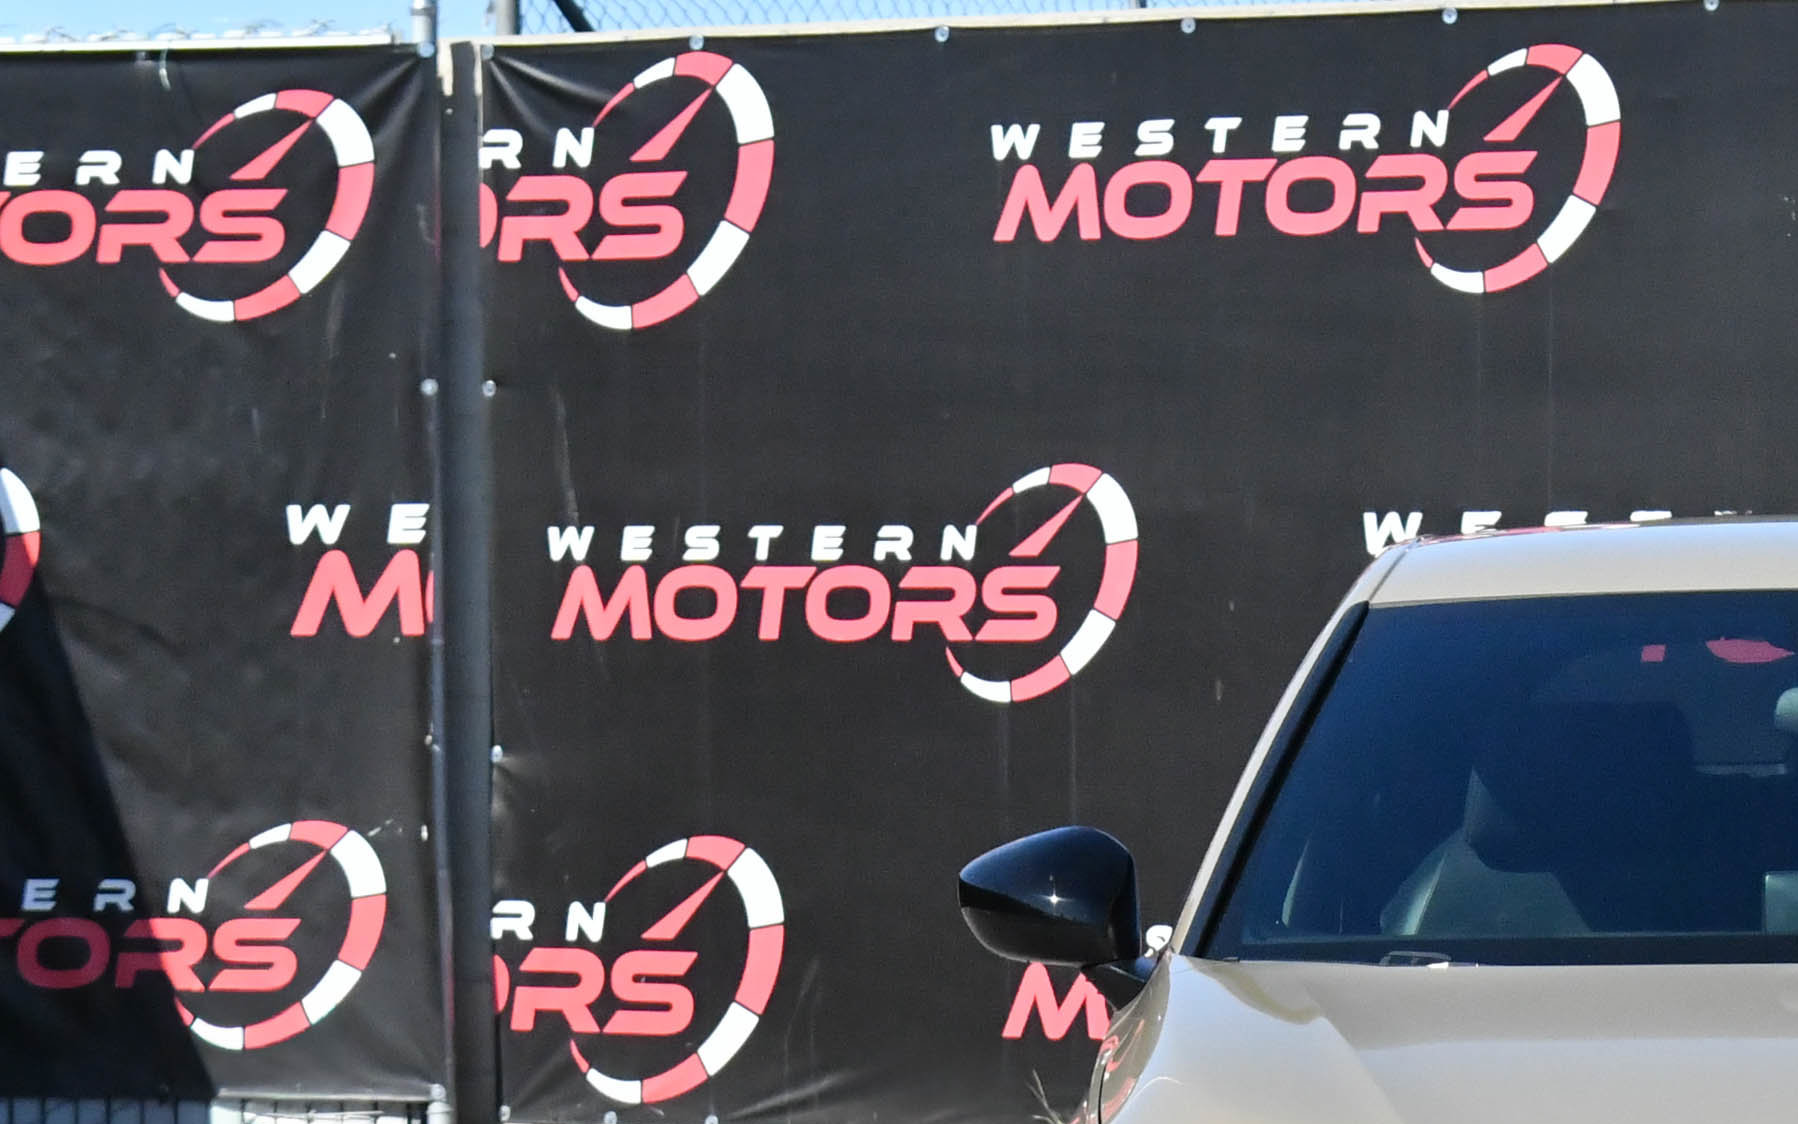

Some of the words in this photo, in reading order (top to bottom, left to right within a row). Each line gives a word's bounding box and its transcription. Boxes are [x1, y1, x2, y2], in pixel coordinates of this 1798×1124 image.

[990, 109, 1450, 162] WESTERN
[993, 150, 1539, 242] MOTORS
[547, 523, 978, 563] WESTERN
[550, 562, 1061, 643] MOTORS
